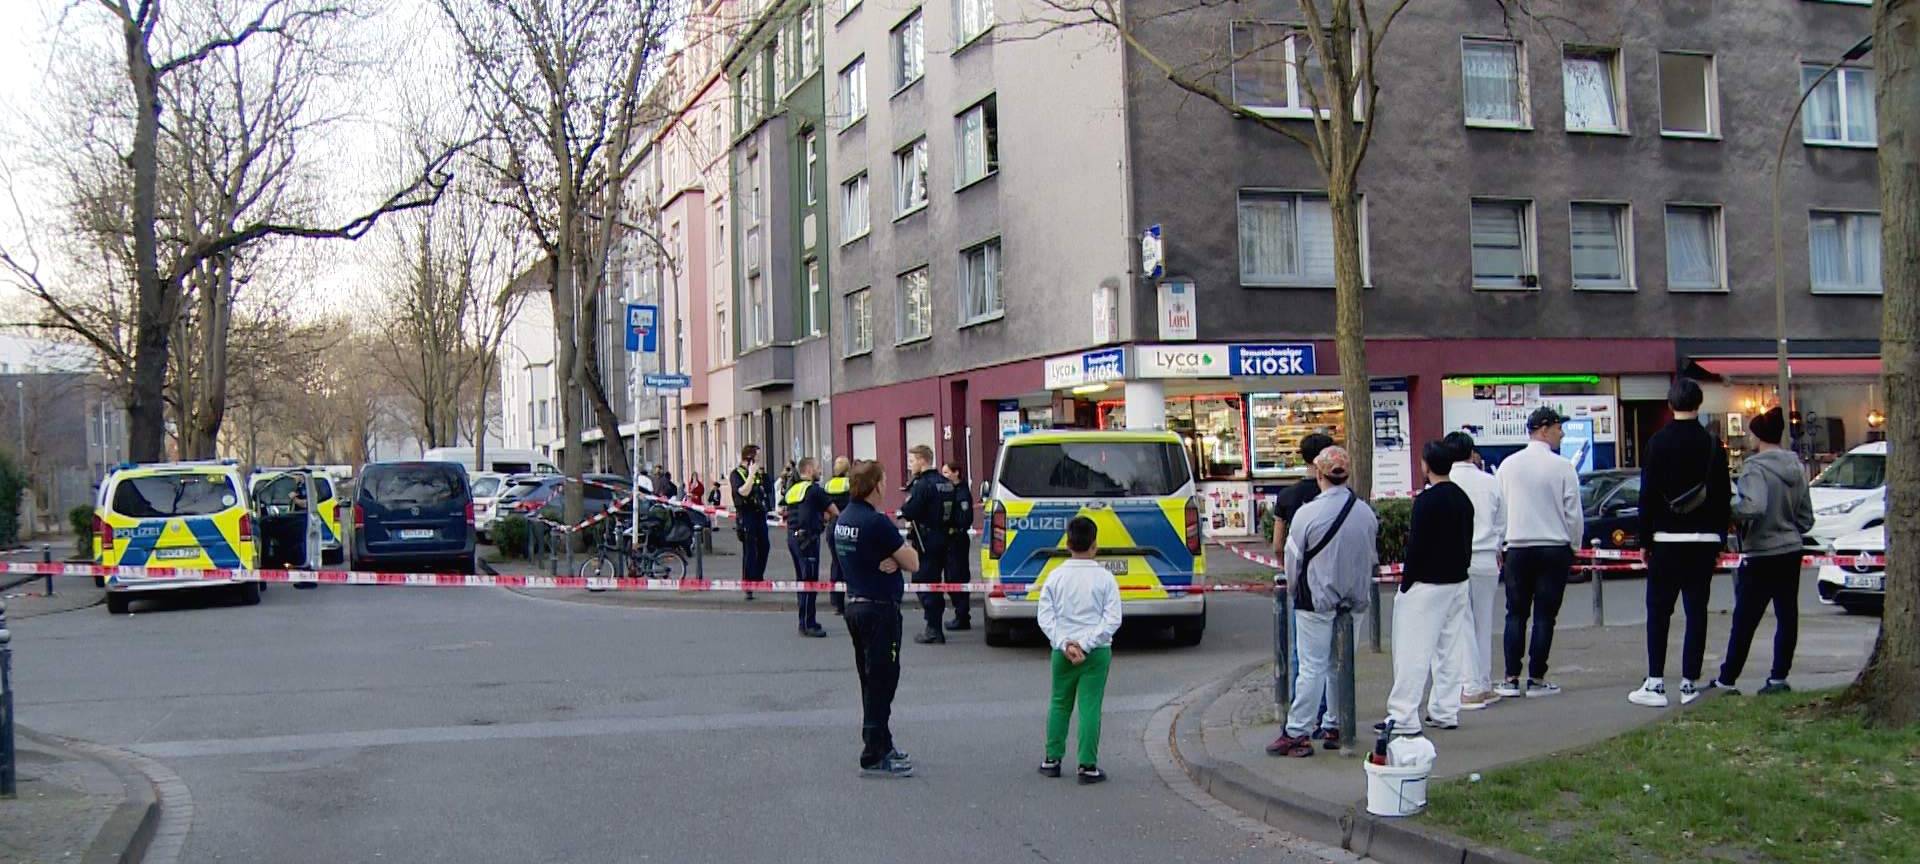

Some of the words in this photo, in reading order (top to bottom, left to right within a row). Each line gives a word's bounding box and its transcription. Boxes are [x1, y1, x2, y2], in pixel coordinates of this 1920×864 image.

[1157, 351, 1199, 367] Lyca
[1240, 357, 1304, 374] KIOSK
[1051, 363, 1071, 378] Lyca
[1088, 363, 1119, 381] KIOSK
[1373, 399, 1396, 408] Lyca
[1007, 516, 1068, 530] POLIZEI
[113, 527, 160, 538] POLIZEI
